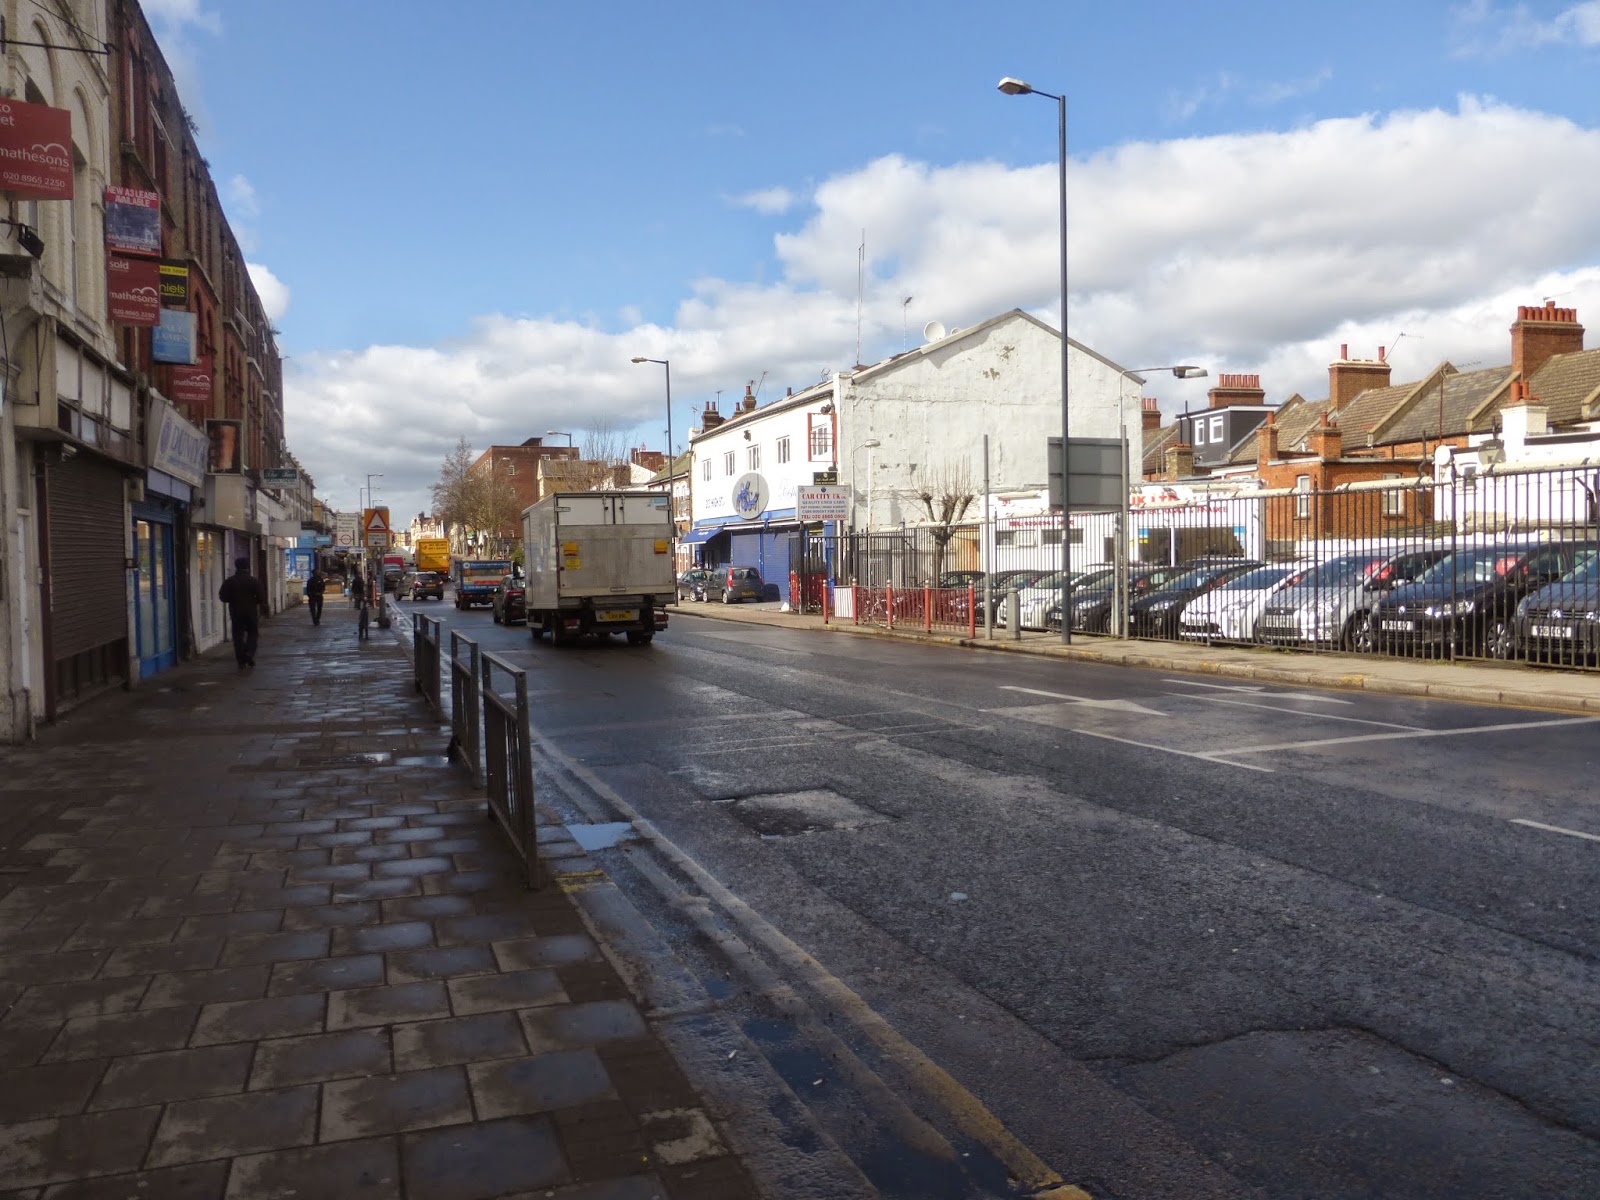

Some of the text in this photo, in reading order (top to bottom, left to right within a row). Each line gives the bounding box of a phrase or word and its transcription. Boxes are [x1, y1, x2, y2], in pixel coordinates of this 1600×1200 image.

[0, 115, 14, 126] et
[0, 147, 69, 167] mathesons
[3, 171, 20, 181] 020
[22, 174, 42, 185] 8965
[44, 177, 65, 188] 2250
[106, 185, 157, 201] NEW A3 LEASE
[115, 195, 150, 207] AVAILABLE
[110, 260, 129, 270] sold
[160, 282, 186, 294] niels
[110, 291, 159, 304] mathesons
